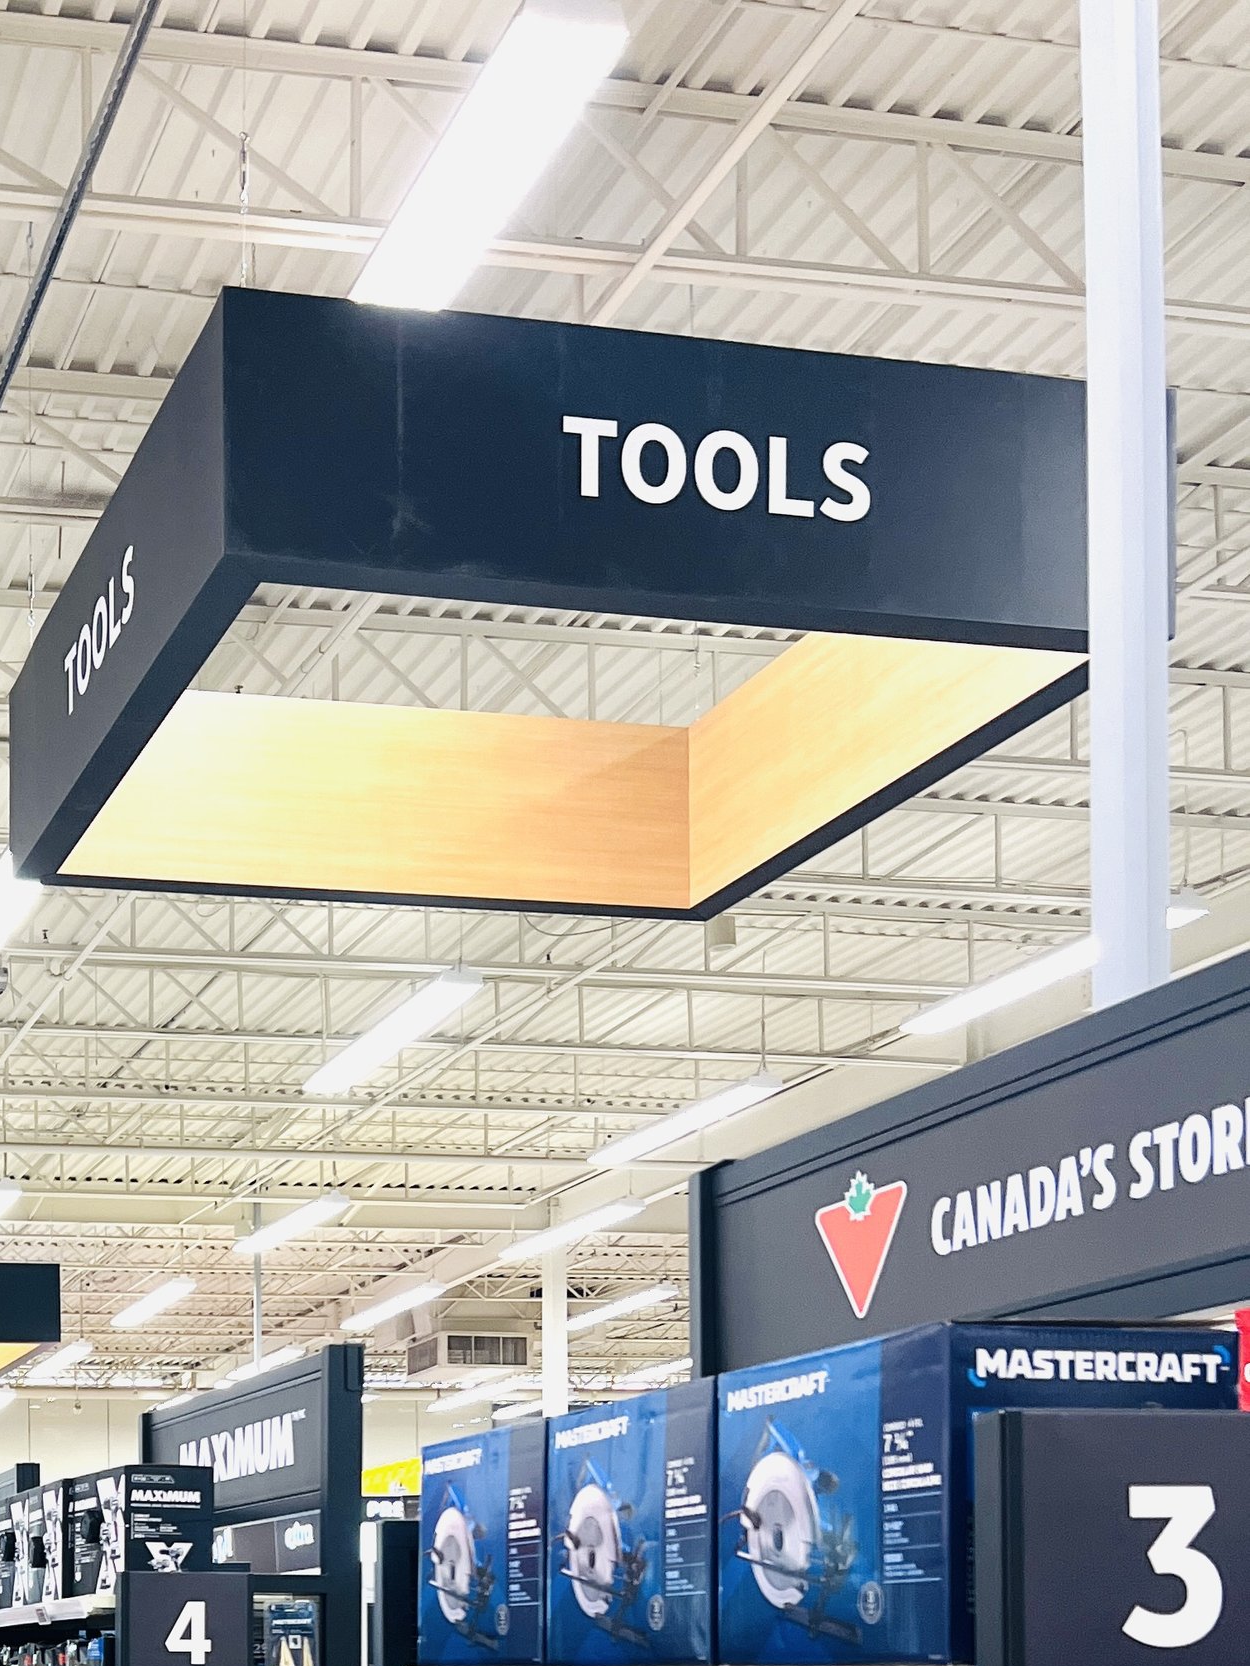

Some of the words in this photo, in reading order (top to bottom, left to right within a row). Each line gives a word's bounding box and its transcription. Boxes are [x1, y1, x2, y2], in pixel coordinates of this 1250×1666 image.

[562, 415, 872, 523] TOOLS
[64, 544, 136, 716] TOOLS
[931, 1142, 1117, 1257] CANADA'S
[726, 1370, 830, 1413] MASTERCRAFT
[975, 1346, 1223, 1388] MASTERCRAFT
[178, 1414, 296, 1485] MAXIMUM
[130, 1489, 202, 1504] MAXIMUM
[1121, 1484, 1226, 1649] 3
[164, 1600, 212, 1666] 4
